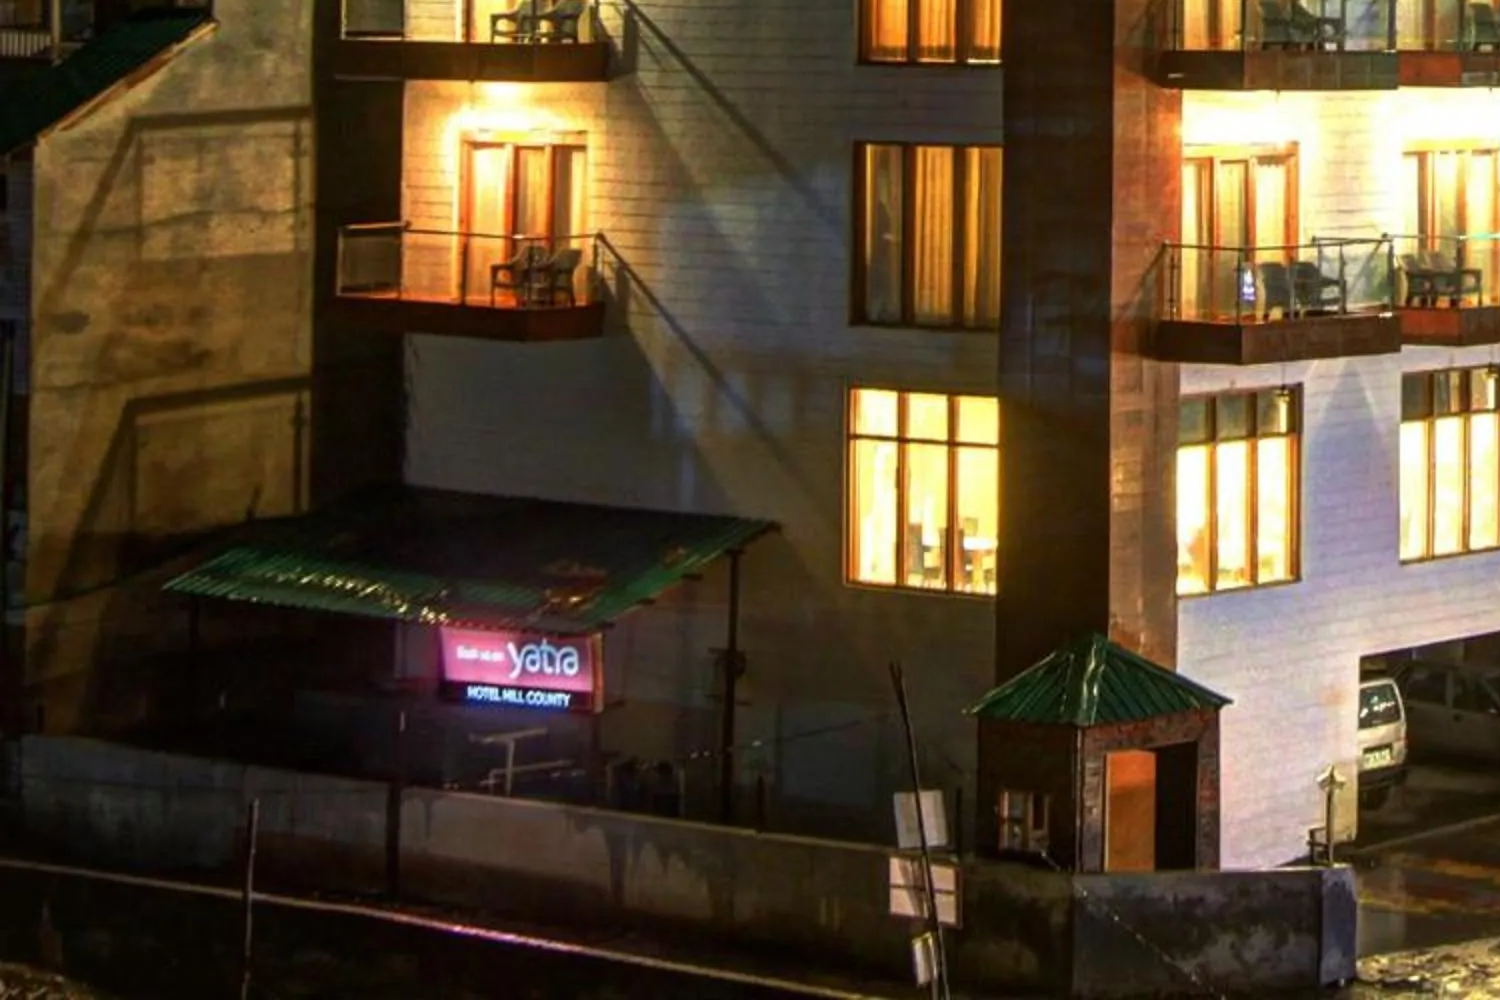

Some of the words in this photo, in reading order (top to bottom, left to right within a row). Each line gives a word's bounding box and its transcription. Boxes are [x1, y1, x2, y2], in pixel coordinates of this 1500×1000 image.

[507, 638, 579, 679] yatra
[467, 685, 500, 702] HOTEL
[502, 688, 525, 705] HILL
[525, 690, 571, 708] COUNTY
